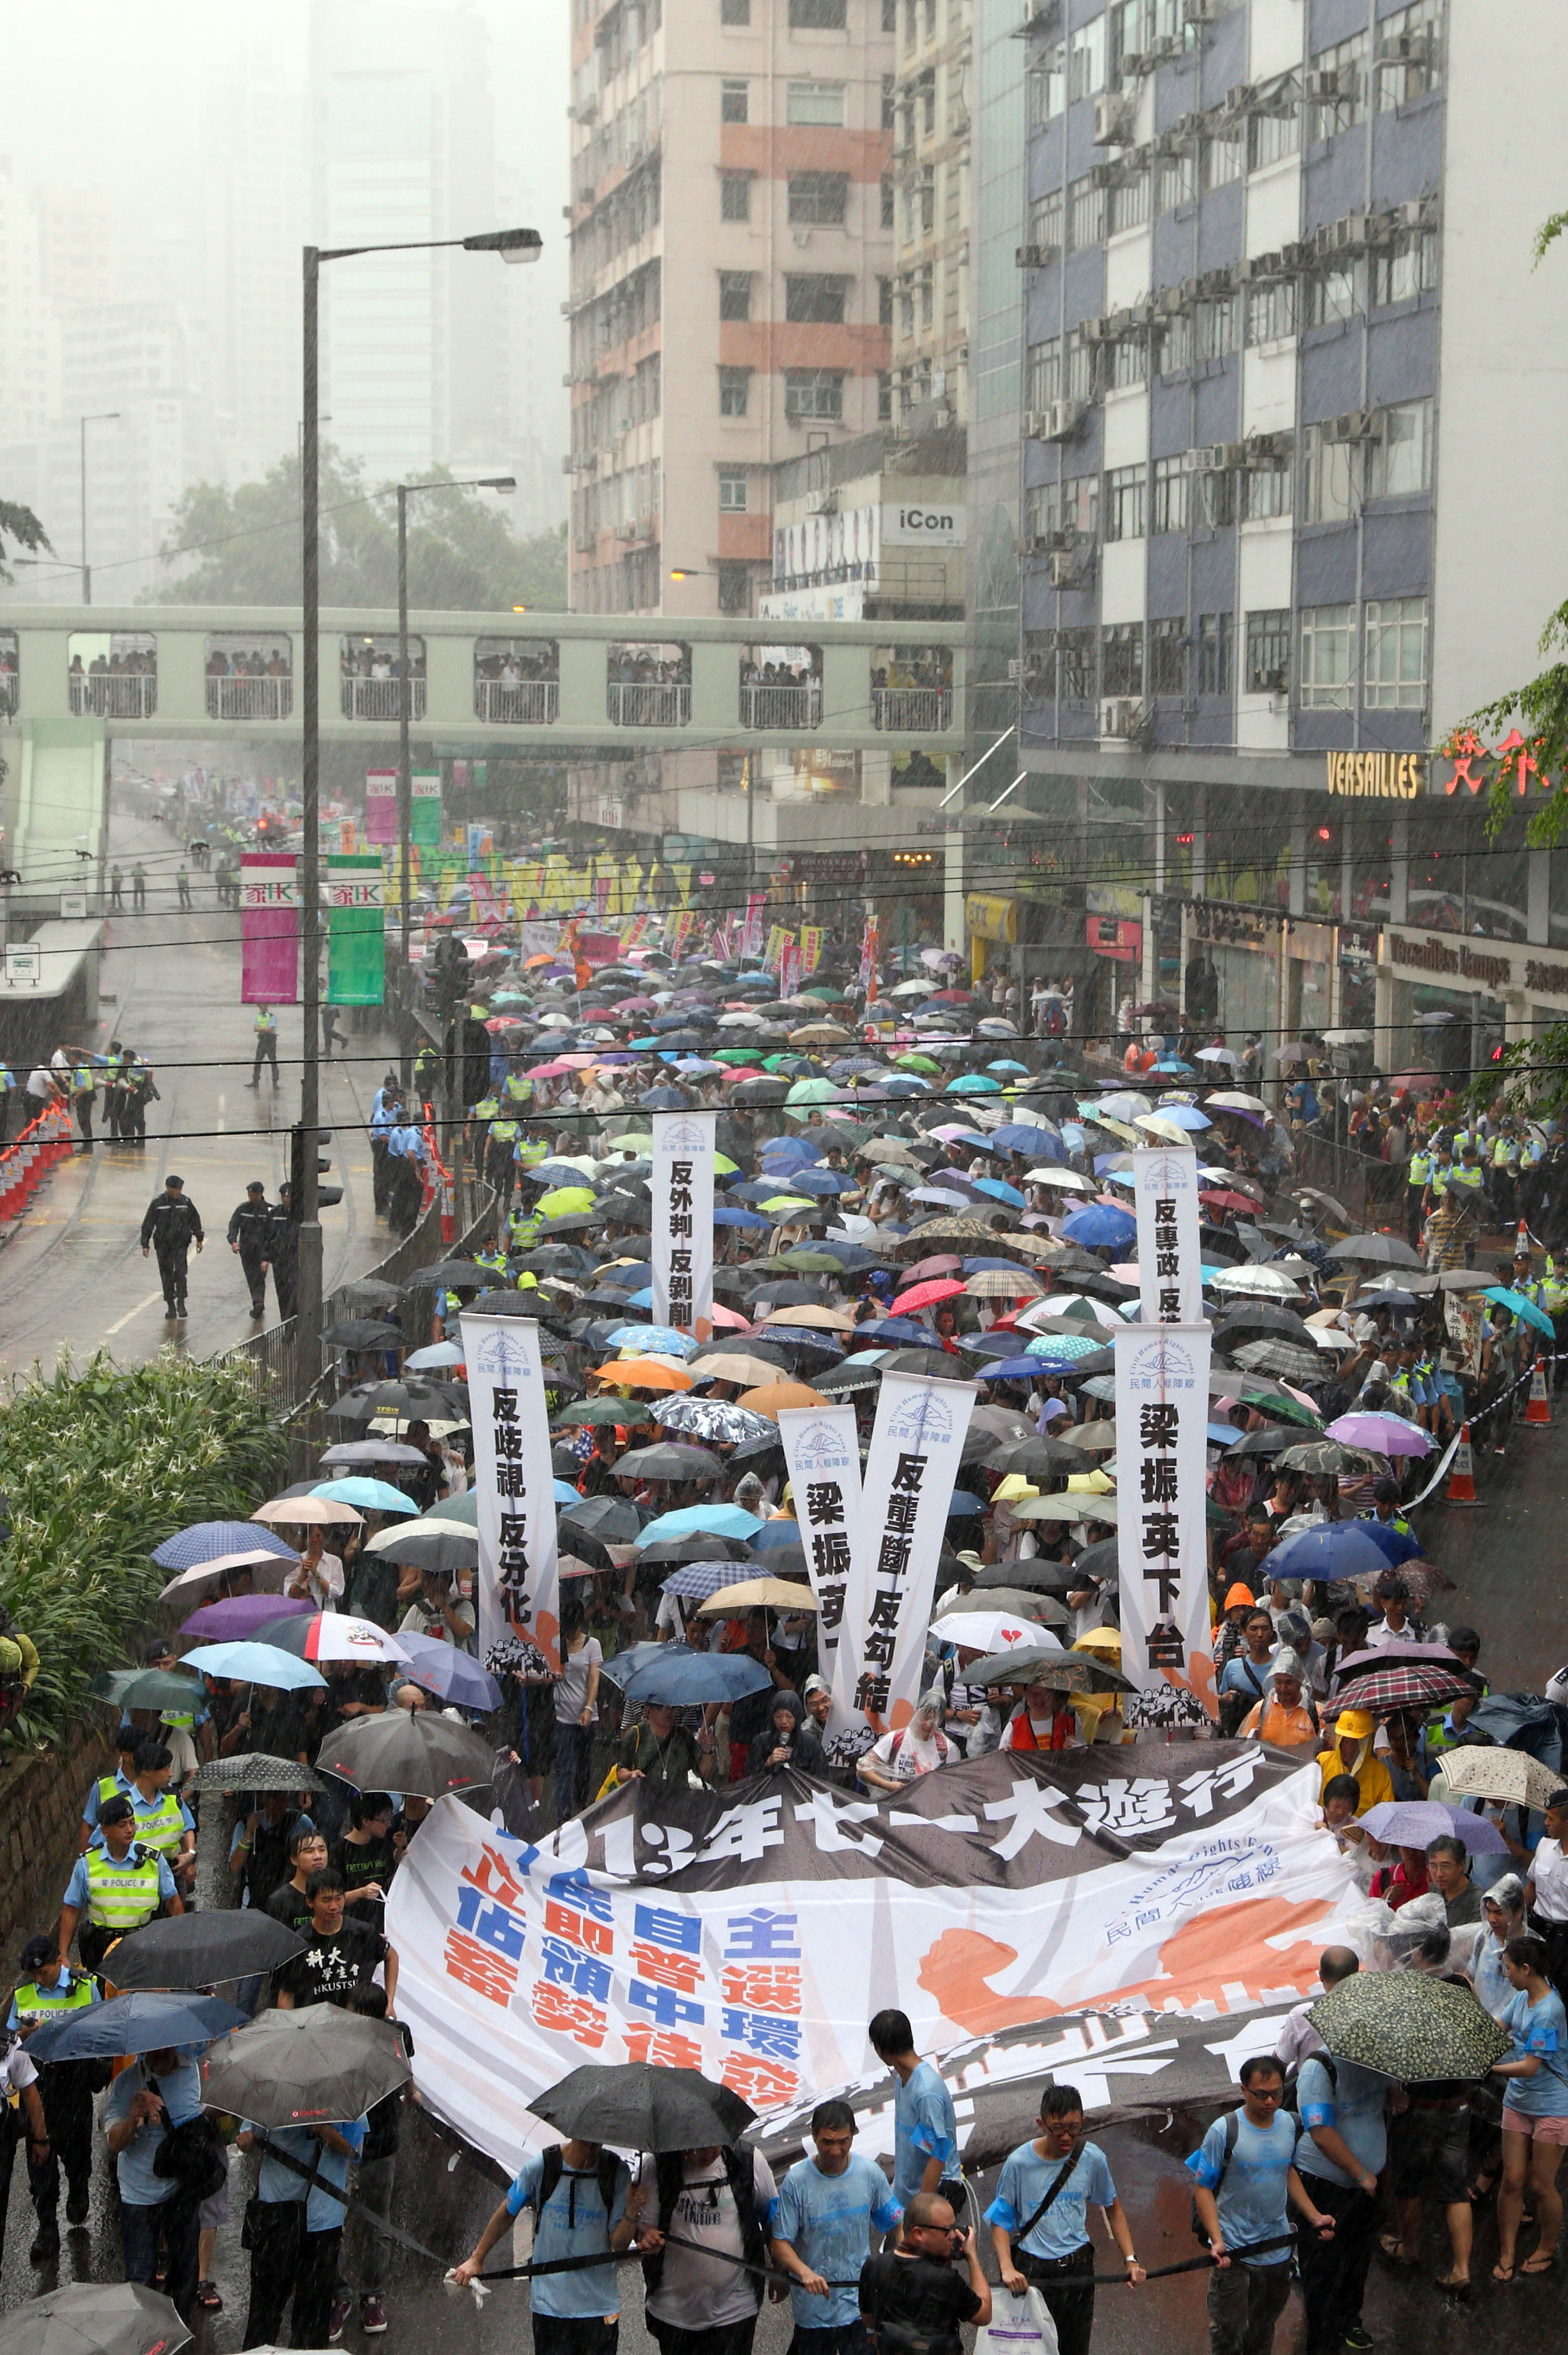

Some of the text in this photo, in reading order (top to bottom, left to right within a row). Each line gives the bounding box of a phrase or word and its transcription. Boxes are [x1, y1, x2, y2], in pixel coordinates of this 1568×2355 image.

[900, 509, 954, 530] iCon
[1327, 751, 1417, 800] VERSAILLES
[669, 1161, 693, 1328] 反外判 反剝削
[1155, 1198, 1180, 1277] 反專政
[492, 1387, 532, 1624] 反歧視 反分化
[1140, 1404, 1186, 1670] 梁振英下台
[853, 1452, 929, 1714] 反壟斷 反勾結
[142, 1818, 165, 1831] POLICE
[490, 1746, 1267, 1876] 013年七一大遊行
[345, 1861, 374, 1874] FREEDOM
[1104, 1857, 1282, 1946] 民間人陣線
[305, 1947, 347, 1969] 科大
[456, 1886, 803, 2061] 佔領中環
[460, 1842, 803, 2015] 立即普選
[39, 2009, 67, 2019] POLICE
[443, 1928, 801, 2106] 蓄勢待發
